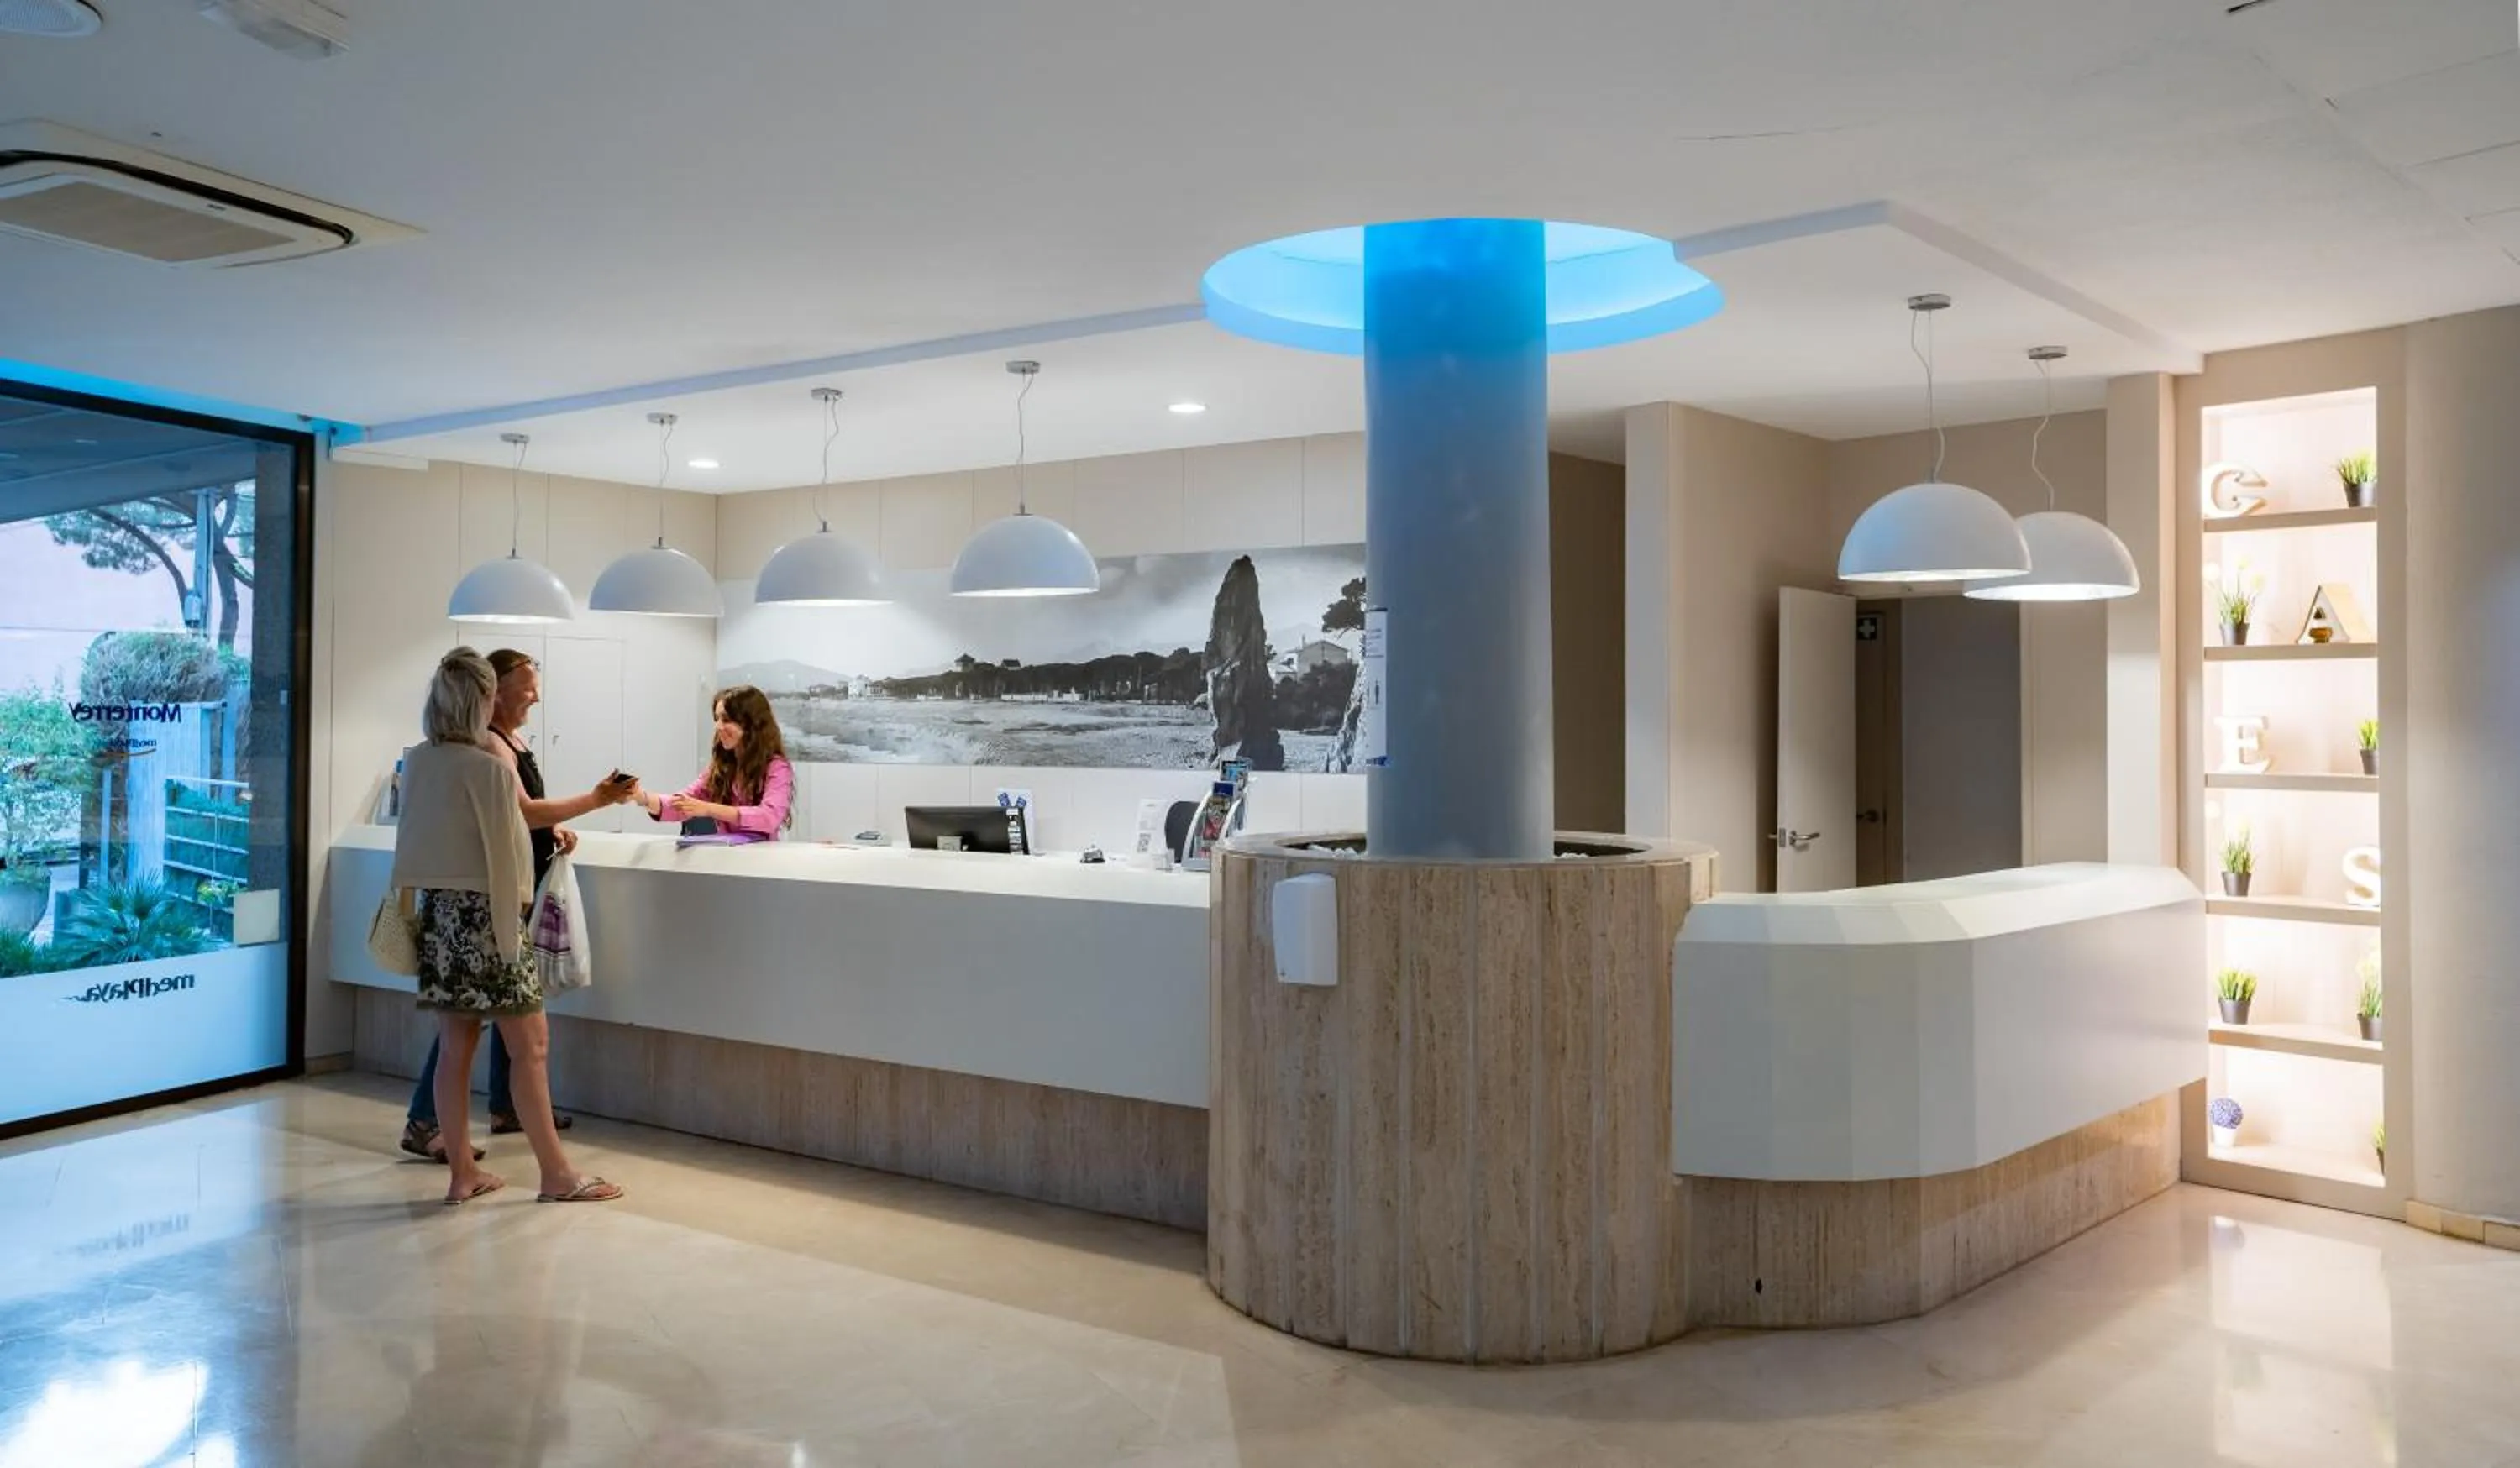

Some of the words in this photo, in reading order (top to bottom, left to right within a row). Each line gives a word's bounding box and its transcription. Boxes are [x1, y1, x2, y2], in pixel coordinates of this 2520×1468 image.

[2296, 584, 2354, 644] A
[2214, 716, 2271, 773] E
[2342, 846, 2381, 906] S
